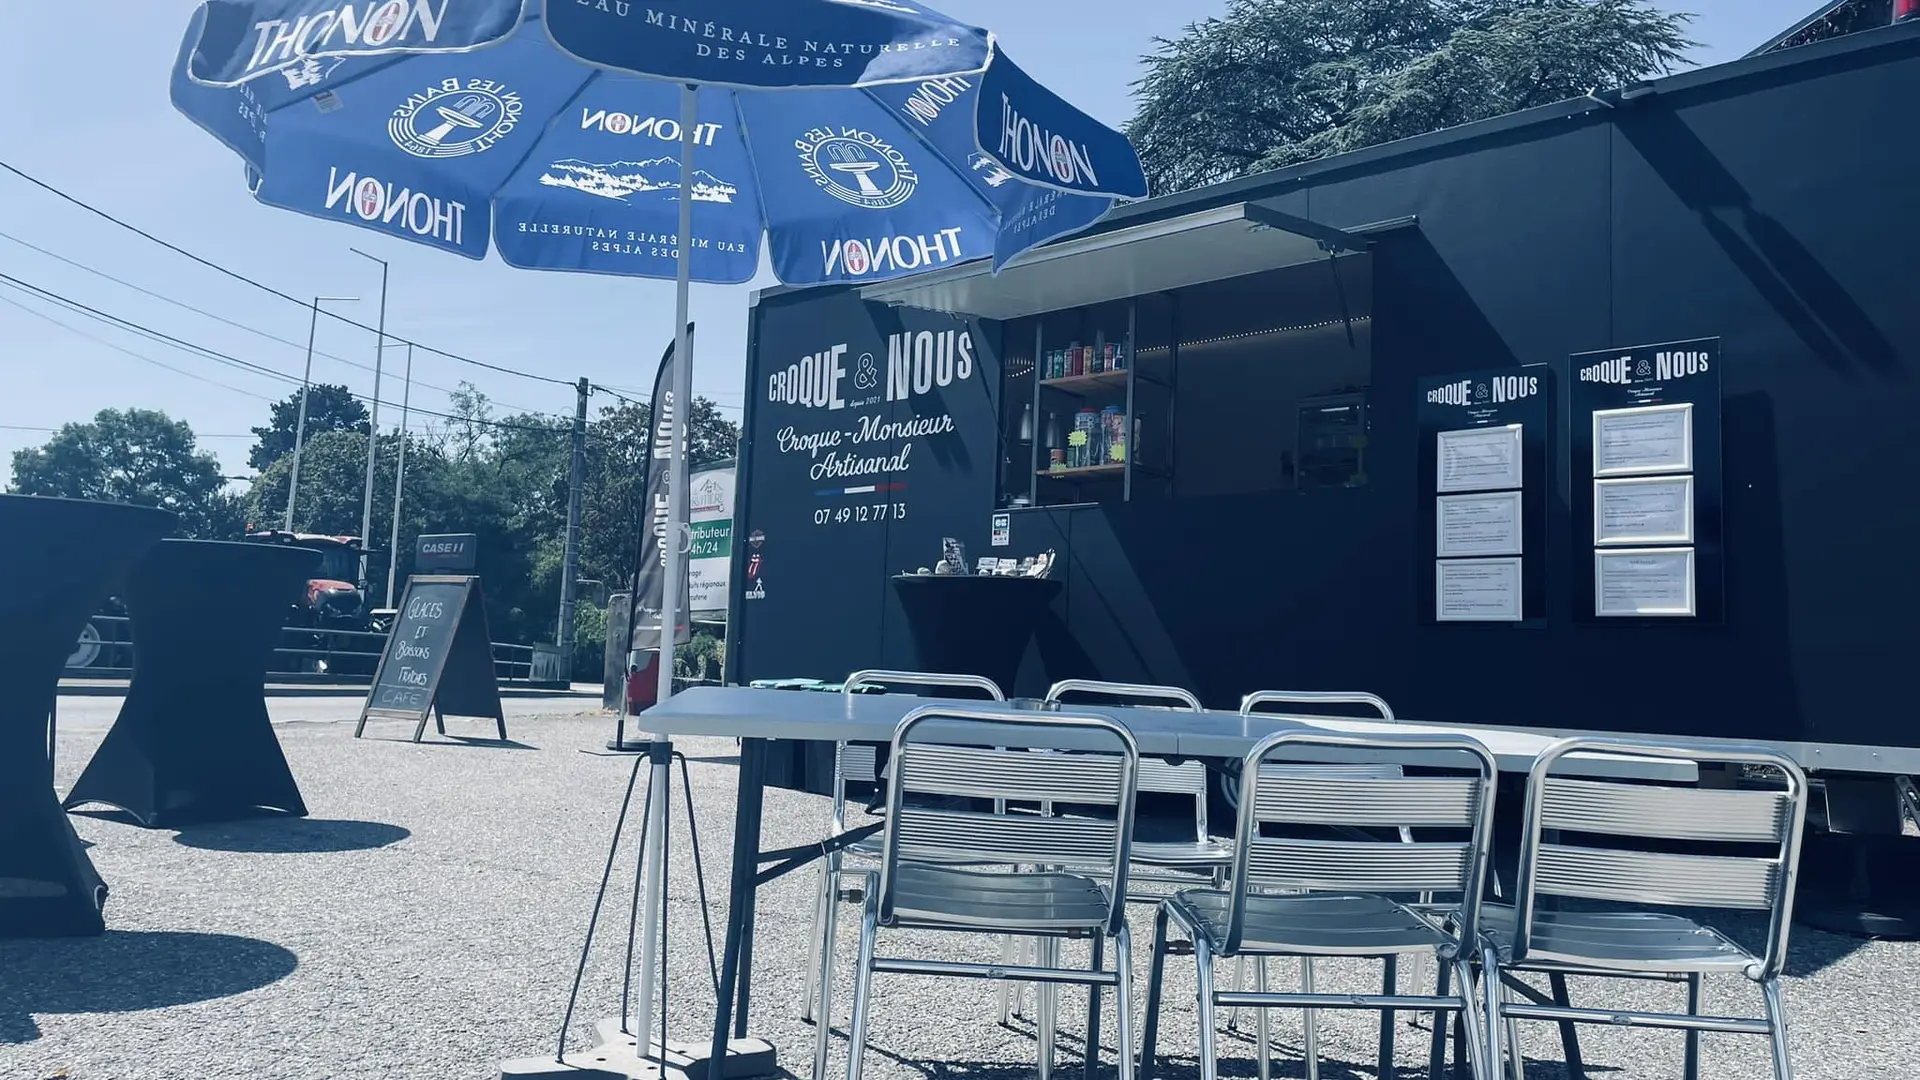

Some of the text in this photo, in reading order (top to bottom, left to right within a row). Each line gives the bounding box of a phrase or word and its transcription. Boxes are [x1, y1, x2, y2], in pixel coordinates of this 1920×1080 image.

[244, 0, 449, 73] THONON
[644, 8, 788, 50] MINÉRALE
[803, 37, 960, 54] NATURELLE
[695, 43, 843, 68] DES ALPES
[1000, 91, 1099, 188] THONON
[768, 329, 973, 410] CROQUE & NOUS
[1579, 351, 1709, 385] CROQUE & NOUS
[1427, 376, 1538, 406] CROQUE & NOUS
[776, 413, 954, 459] Croque-Monsieur
[810, 443, 911, 481] Artisanal
[814, 502, 906, 525] 07 49 12 77 13
[690, 541, 718, 556] 4h/24
[691, 526, 730, 540] tributeur
[407, 596, 443, 620] GLACES
[414, 626, 429, 639] ET
